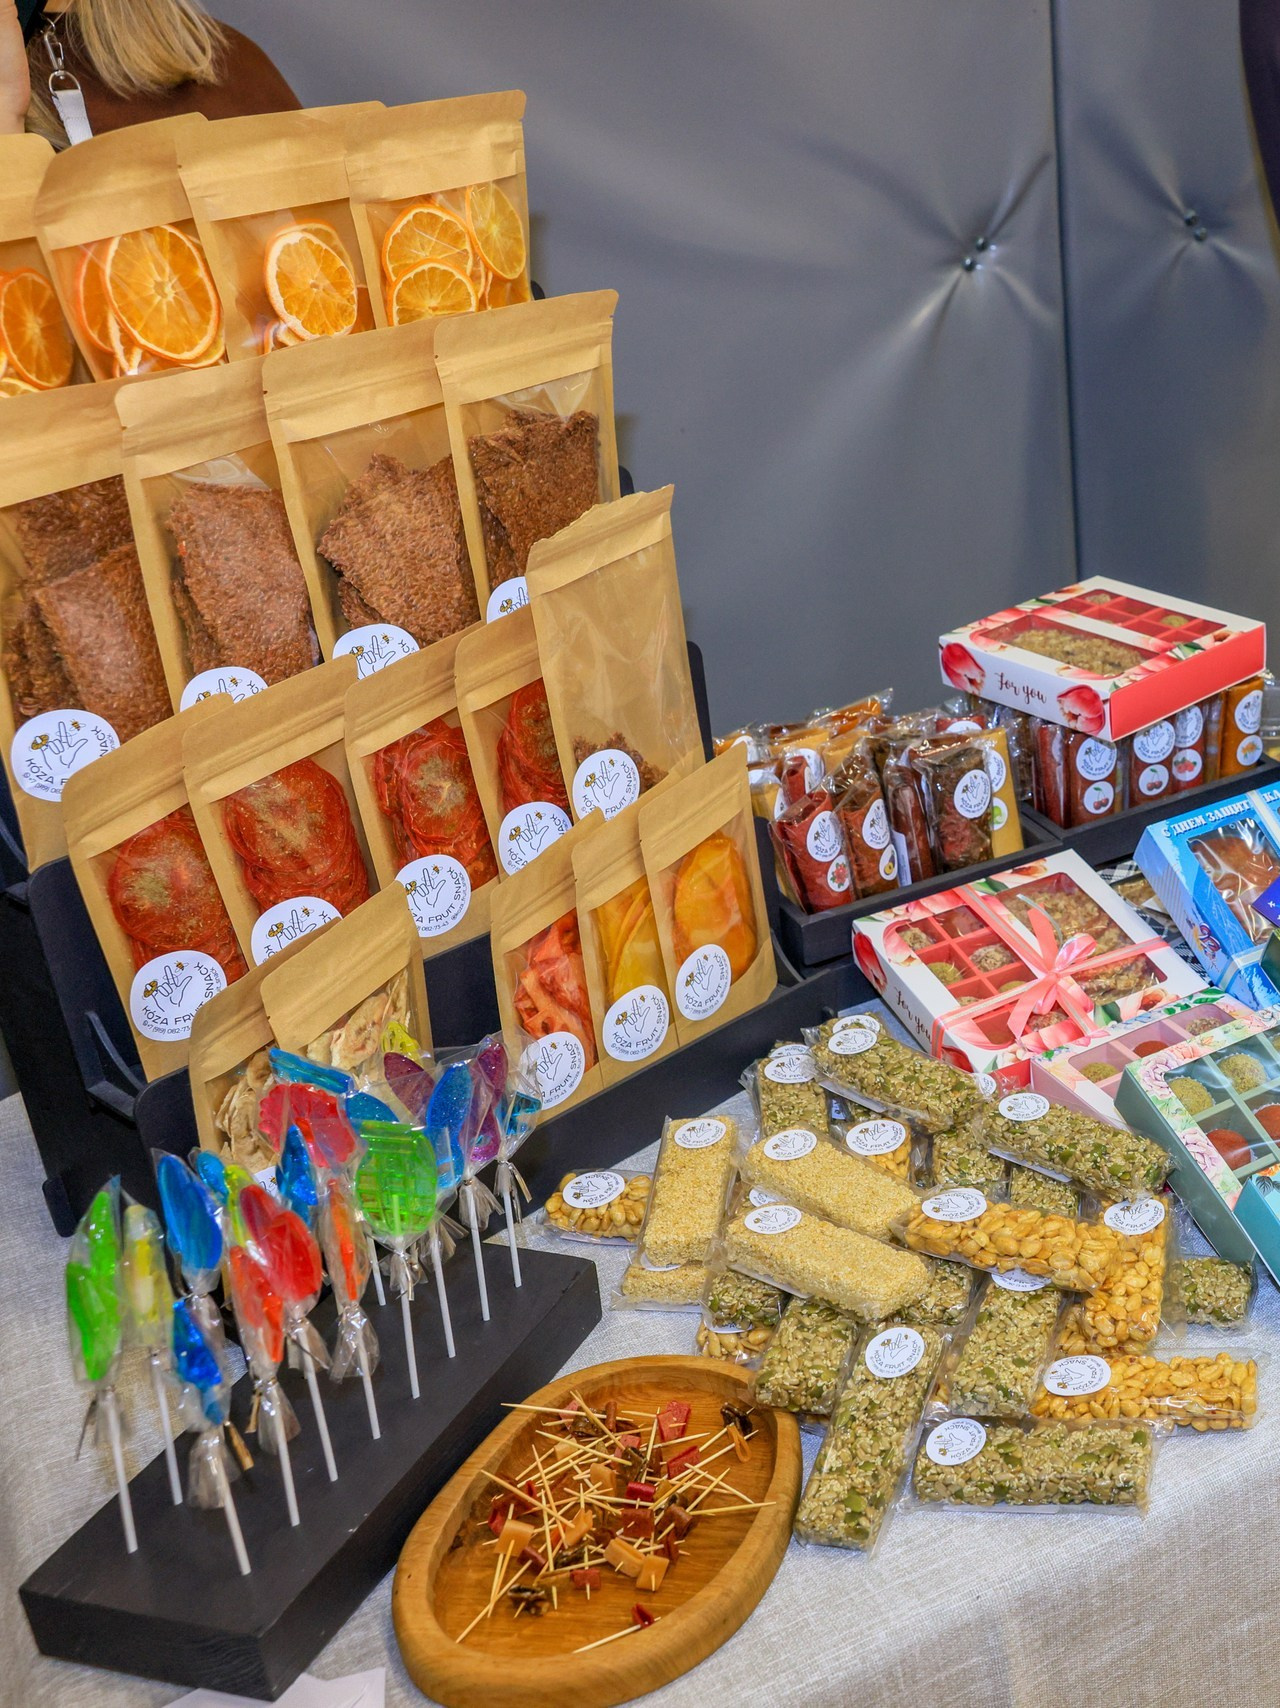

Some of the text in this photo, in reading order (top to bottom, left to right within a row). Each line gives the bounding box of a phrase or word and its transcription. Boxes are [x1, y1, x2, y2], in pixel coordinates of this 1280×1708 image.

[994, 672, 1047, 704] For you
[26, 758, 55, 784] KÓZA
[605, 797, 627, 815] FRUIT
[621, 761, 633, 794] SNACK
[550, 814, 565, 835] ACK
[1162, 827, 1171, 837] С
[1170, 815, 1207, 837] ДНЕМ
[429, 904, 456, 924] FRUIT
[448, 867, 462, 901] SNACK
[713, 952, 725, 981] SNACK
[142, 1005, 169, 1026] KÓZA
[194, 962, 215, 999] SNACK
[705, 984, 722, 1005] FRUIT
[636, 1029, 659, 1048] FRUIT
[651, 994, 663, 1024] SNACK
[550, 1040, 577, 1096] FRUIT SNACK
[884, 1361, 905, 1369] FRUIT
[907, 1340, 918, 1361] SNACK
[1058, 1359, 1087, 1368] SNACK
[1087, 1364, 1098, 1378] FRUIT
[944, 1424, 970, 1432] SNACK
[968, 1431, 978, 1446] FRUIT
